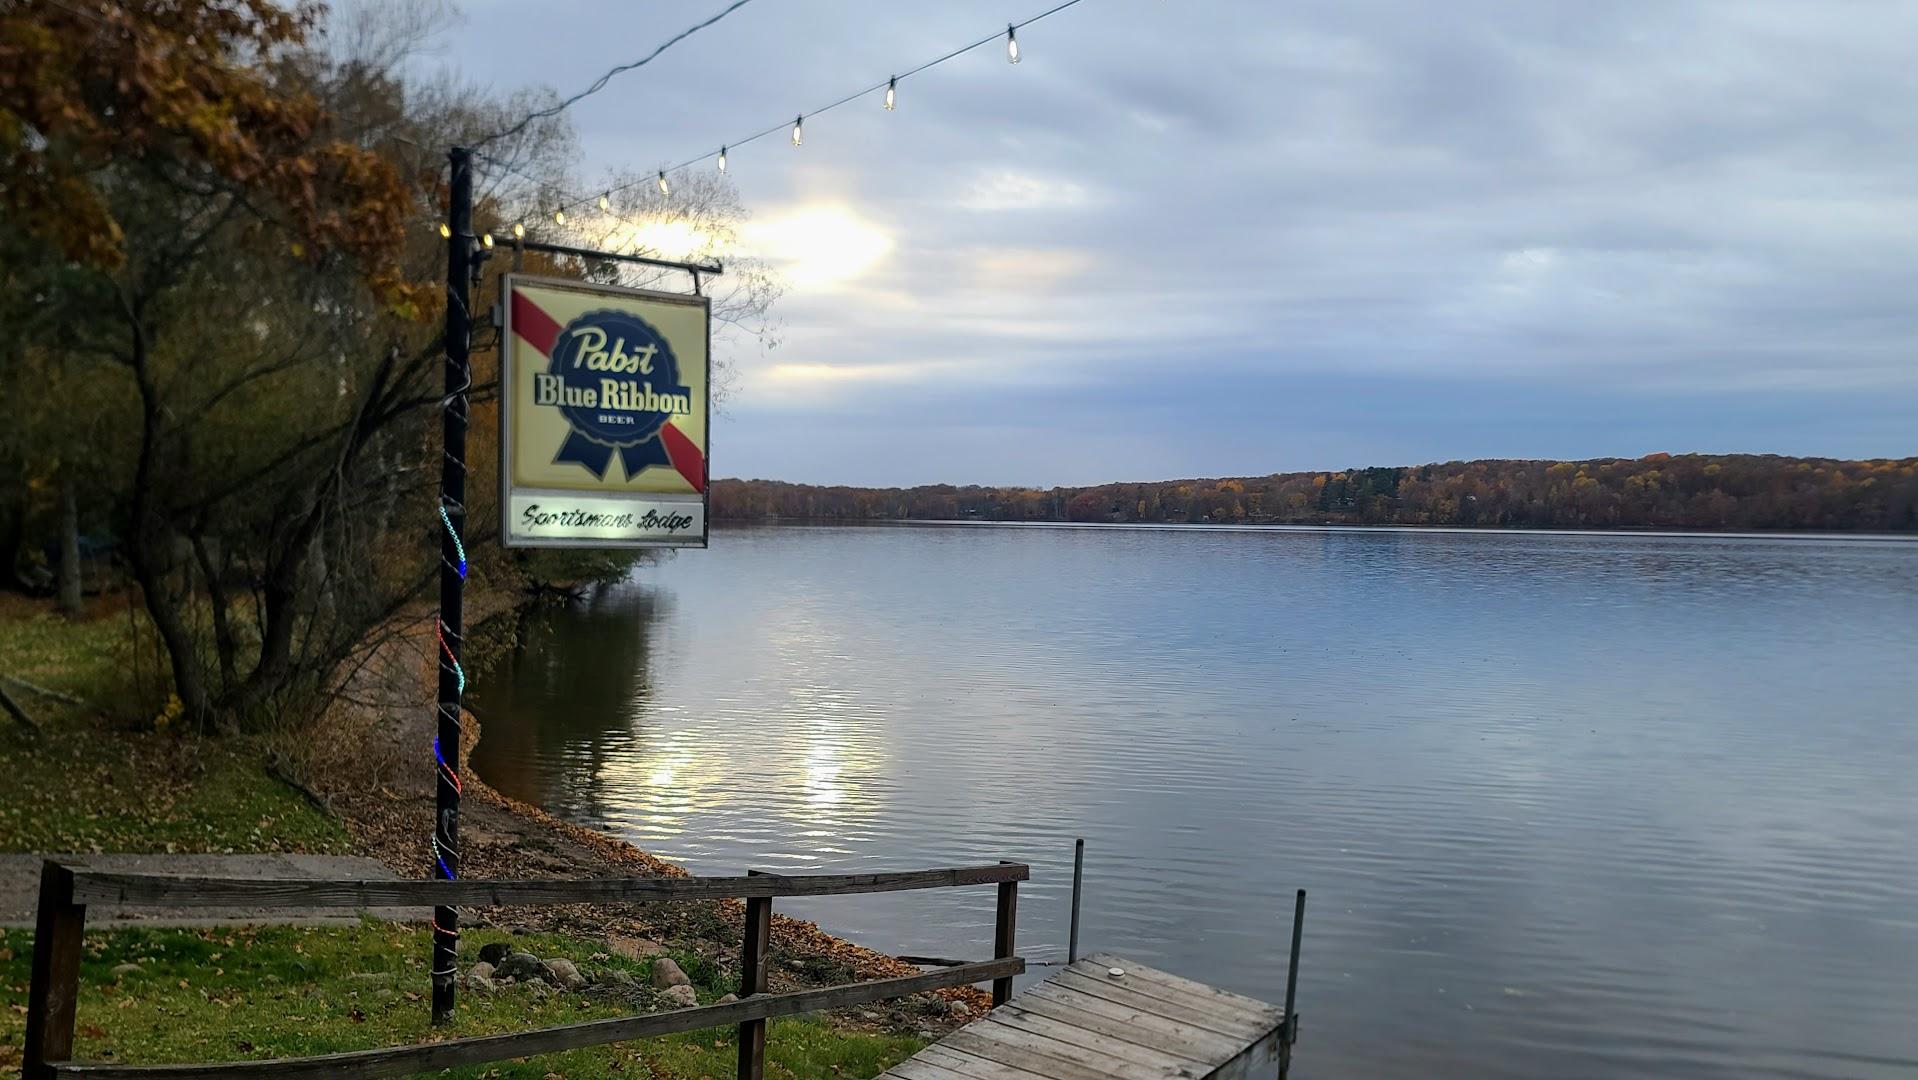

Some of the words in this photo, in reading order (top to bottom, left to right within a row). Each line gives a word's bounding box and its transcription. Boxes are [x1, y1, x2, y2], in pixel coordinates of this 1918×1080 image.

[571, 327, 658, 375] Pabst
[537, 373, 597, 408] Blue
[600, 378, 690, 414] Ribbon
[598, 415, 635, 424] BEER
[637, 508, 693, 534] Lodge
